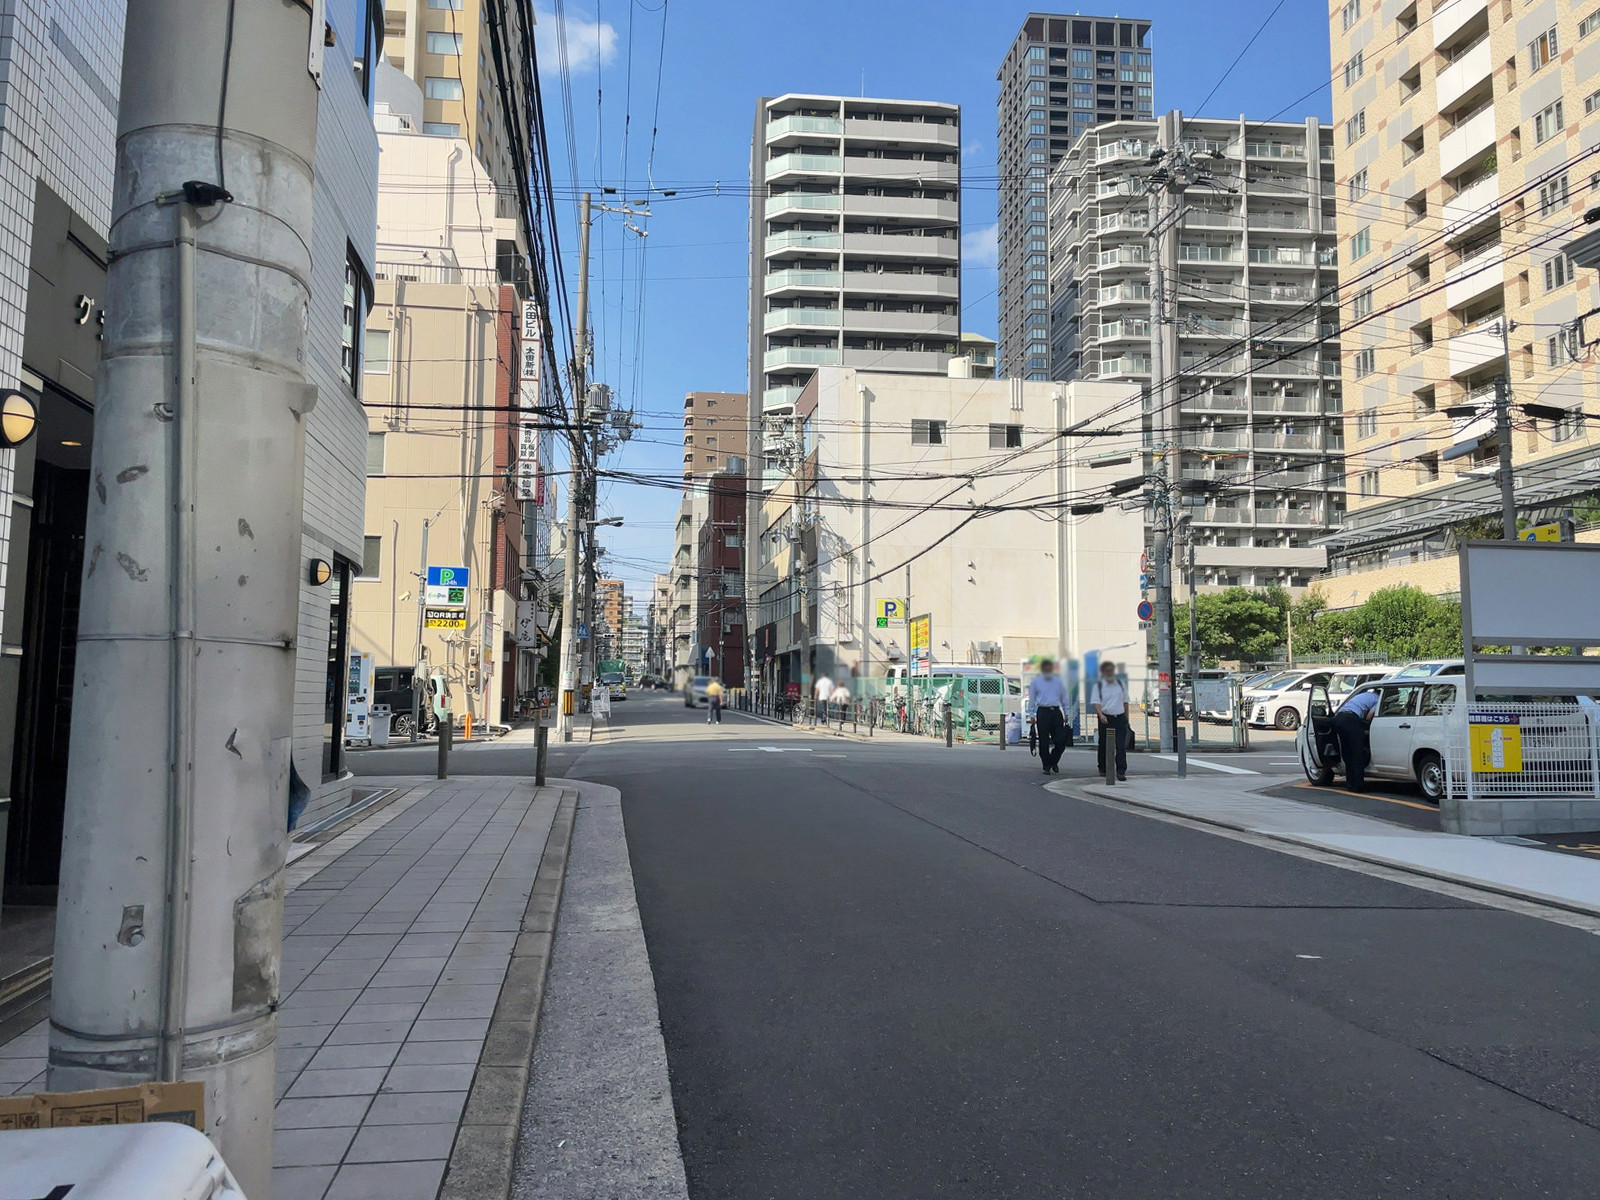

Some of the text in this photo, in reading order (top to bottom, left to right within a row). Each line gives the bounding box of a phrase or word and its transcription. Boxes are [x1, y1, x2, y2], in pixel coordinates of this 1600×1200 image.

[525, 303, 537, 337] 太田ビル
[439, 568, 455, 585] P
[884, 601, 897, 617] P
